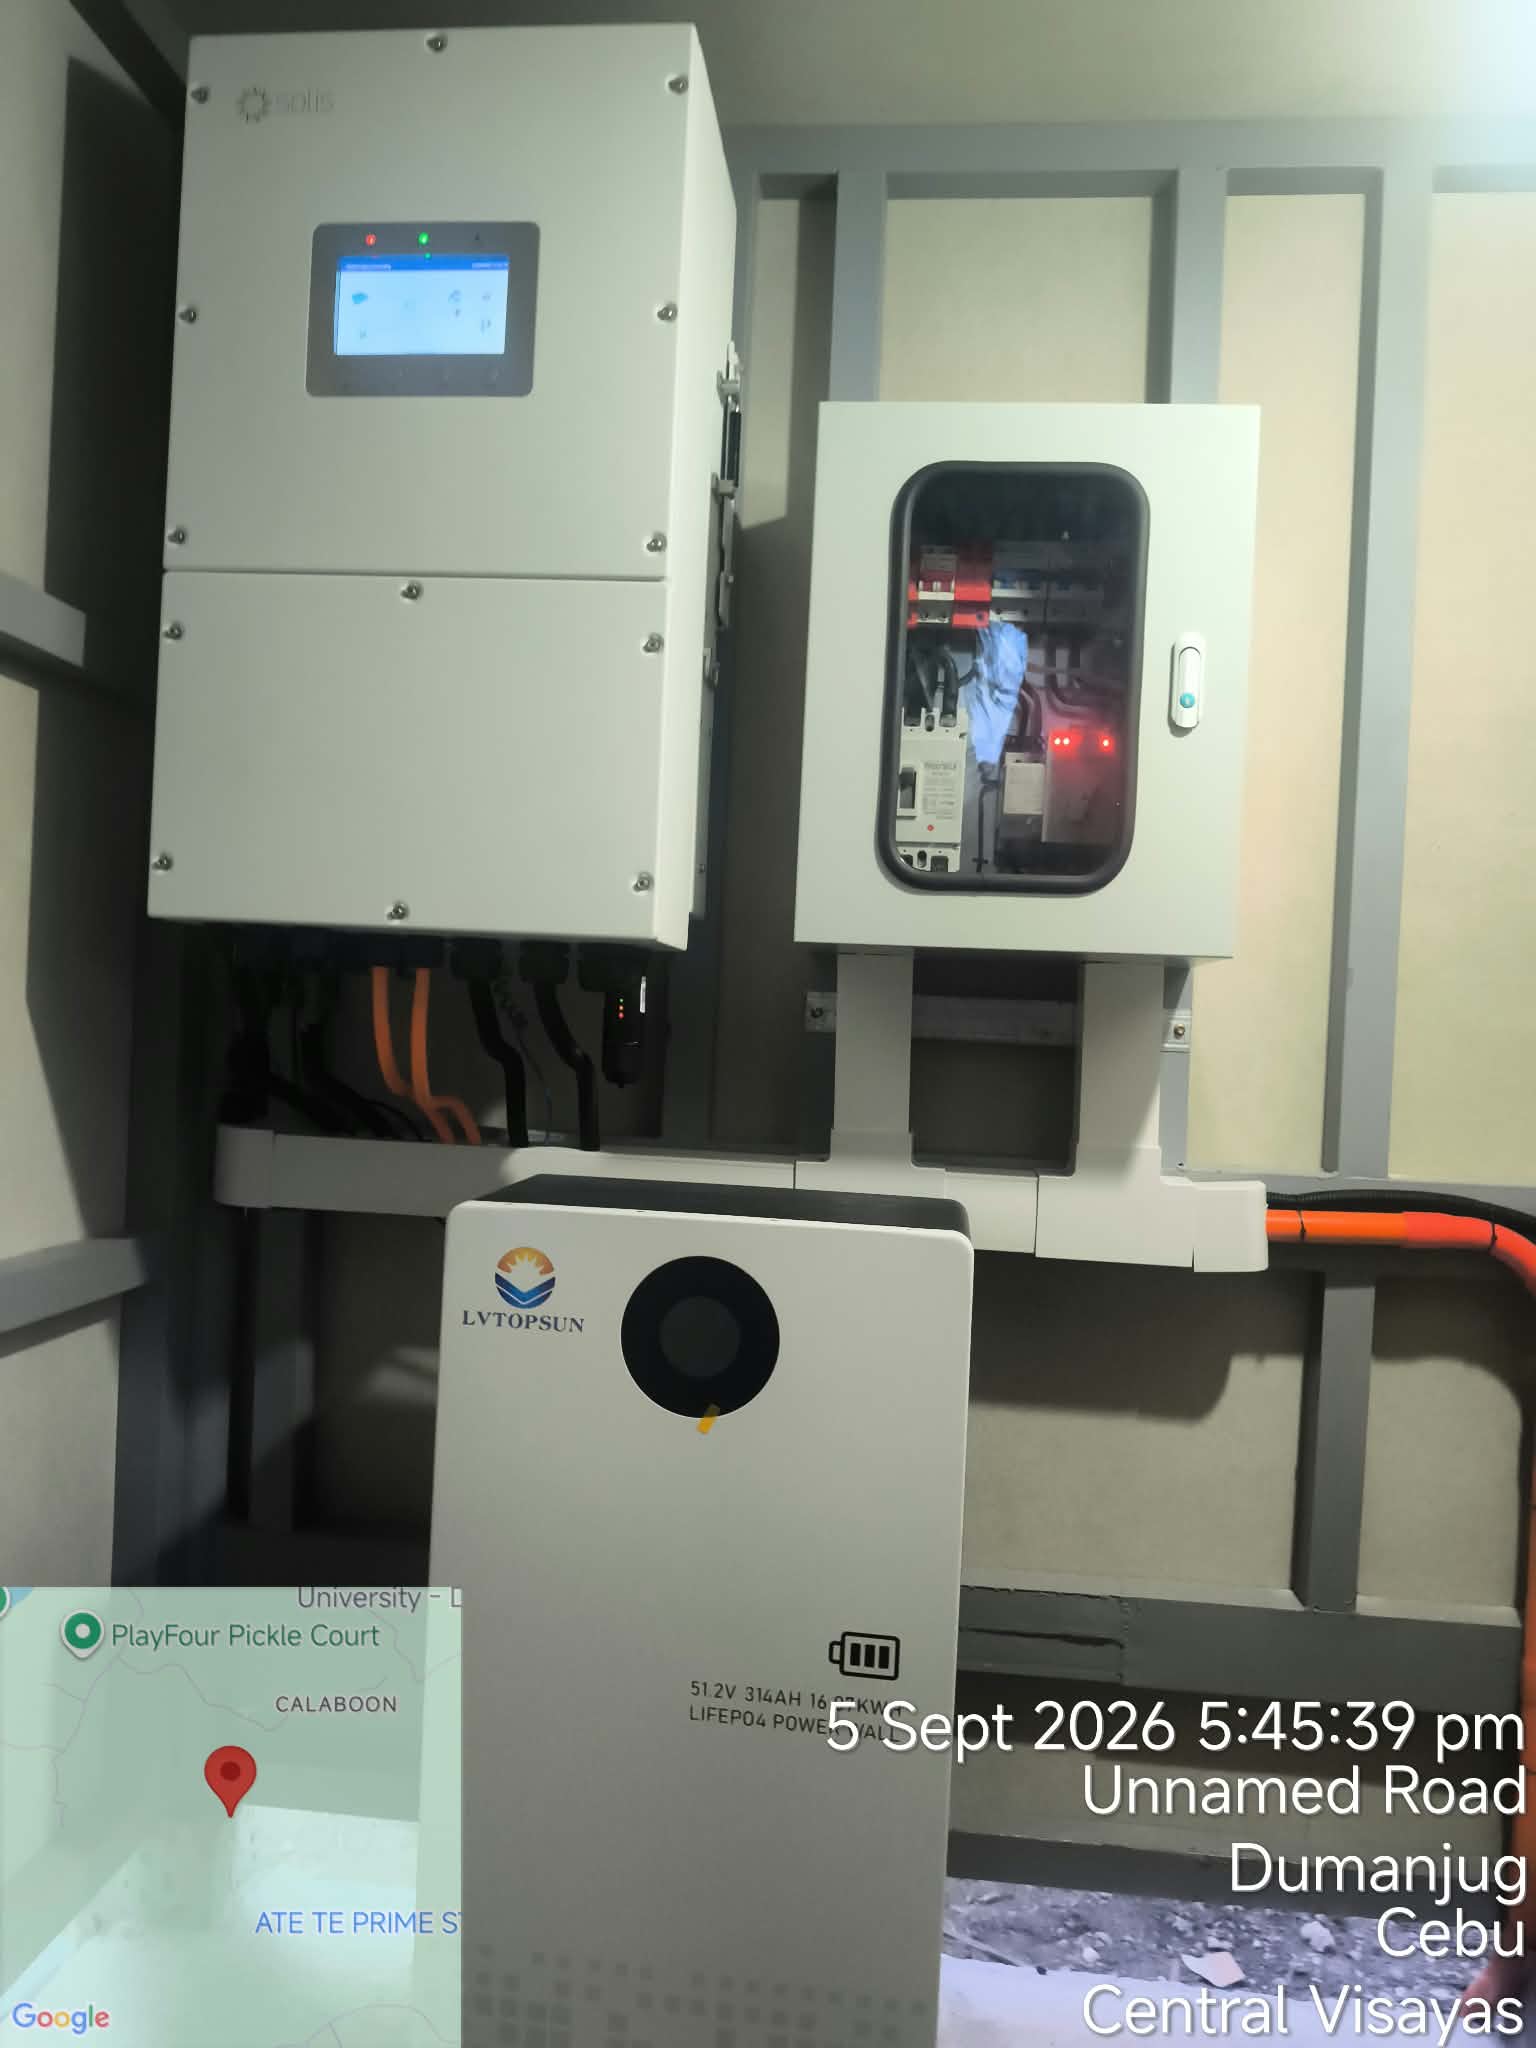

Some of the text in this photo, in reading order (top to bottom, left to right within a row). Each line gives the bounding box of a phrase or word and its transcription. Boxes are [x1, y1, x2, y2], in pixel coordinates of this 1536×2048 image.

[462, 1310, 585, 1333] LVTOPSUN
[690, 1681, 737, 1699] 51.2V
[744, 1686, 801, 1706] 314AH
[689, 1704, 767, 1728] LIFEPO4
